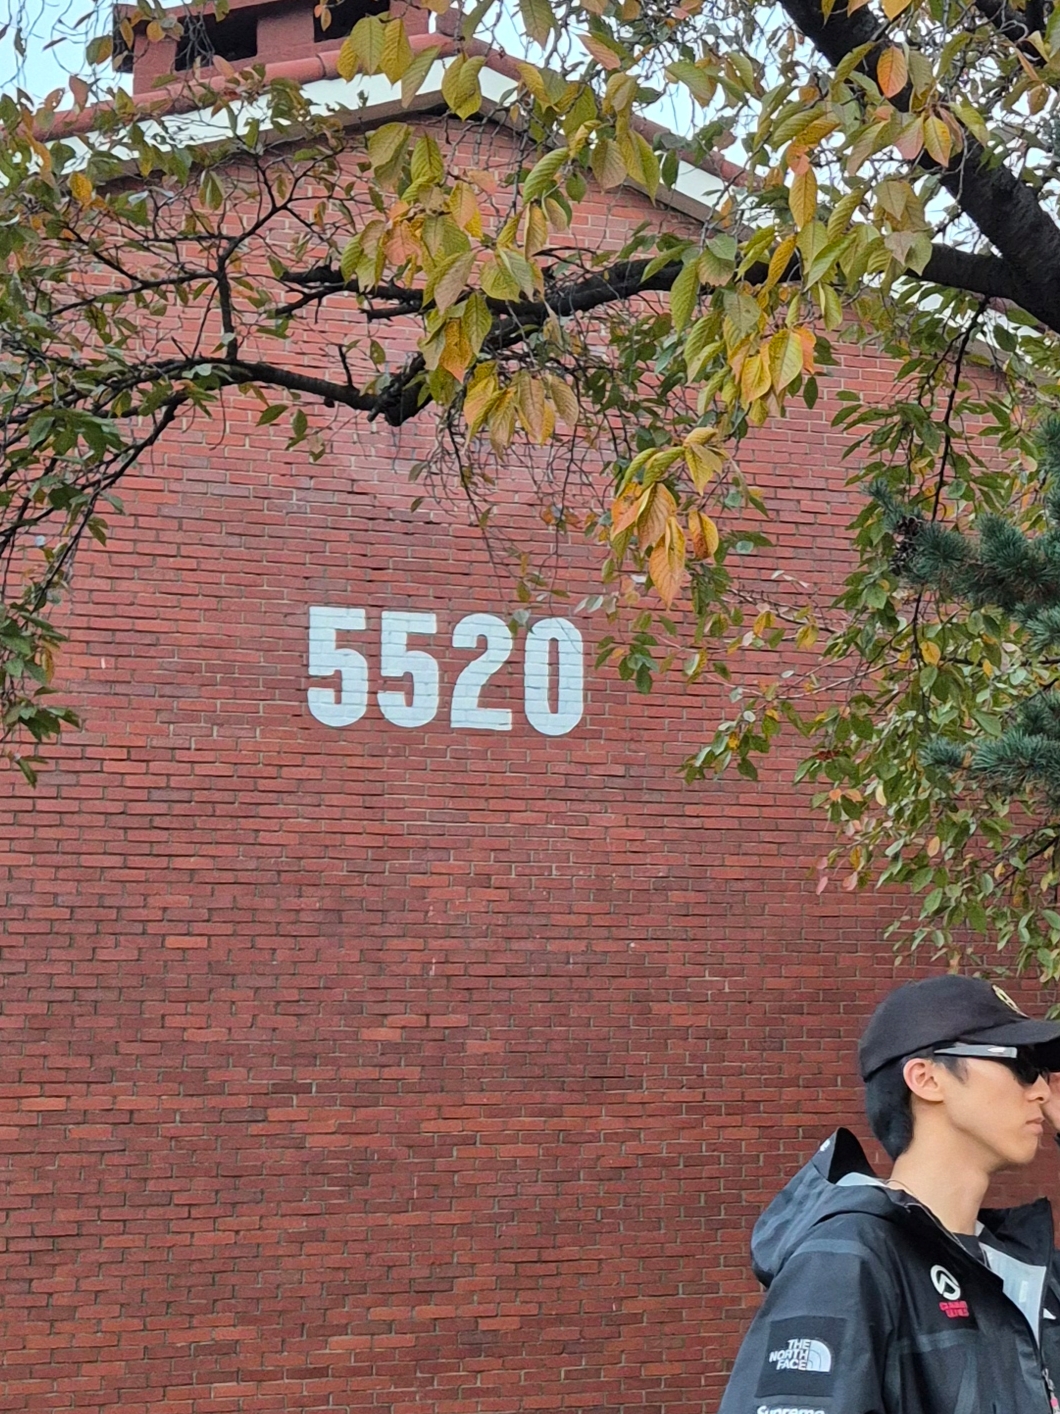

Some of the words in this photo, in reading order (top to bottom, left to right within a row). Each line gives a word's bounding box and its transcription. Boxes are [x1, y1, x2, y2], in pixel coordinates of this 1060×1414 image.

[306, 605, 584, 736] 5520
[787, 1338, 811, 1350] THE
[769, 1348, 809, 1363] NORTH
[776, 1358, 808, 1371] FACE
